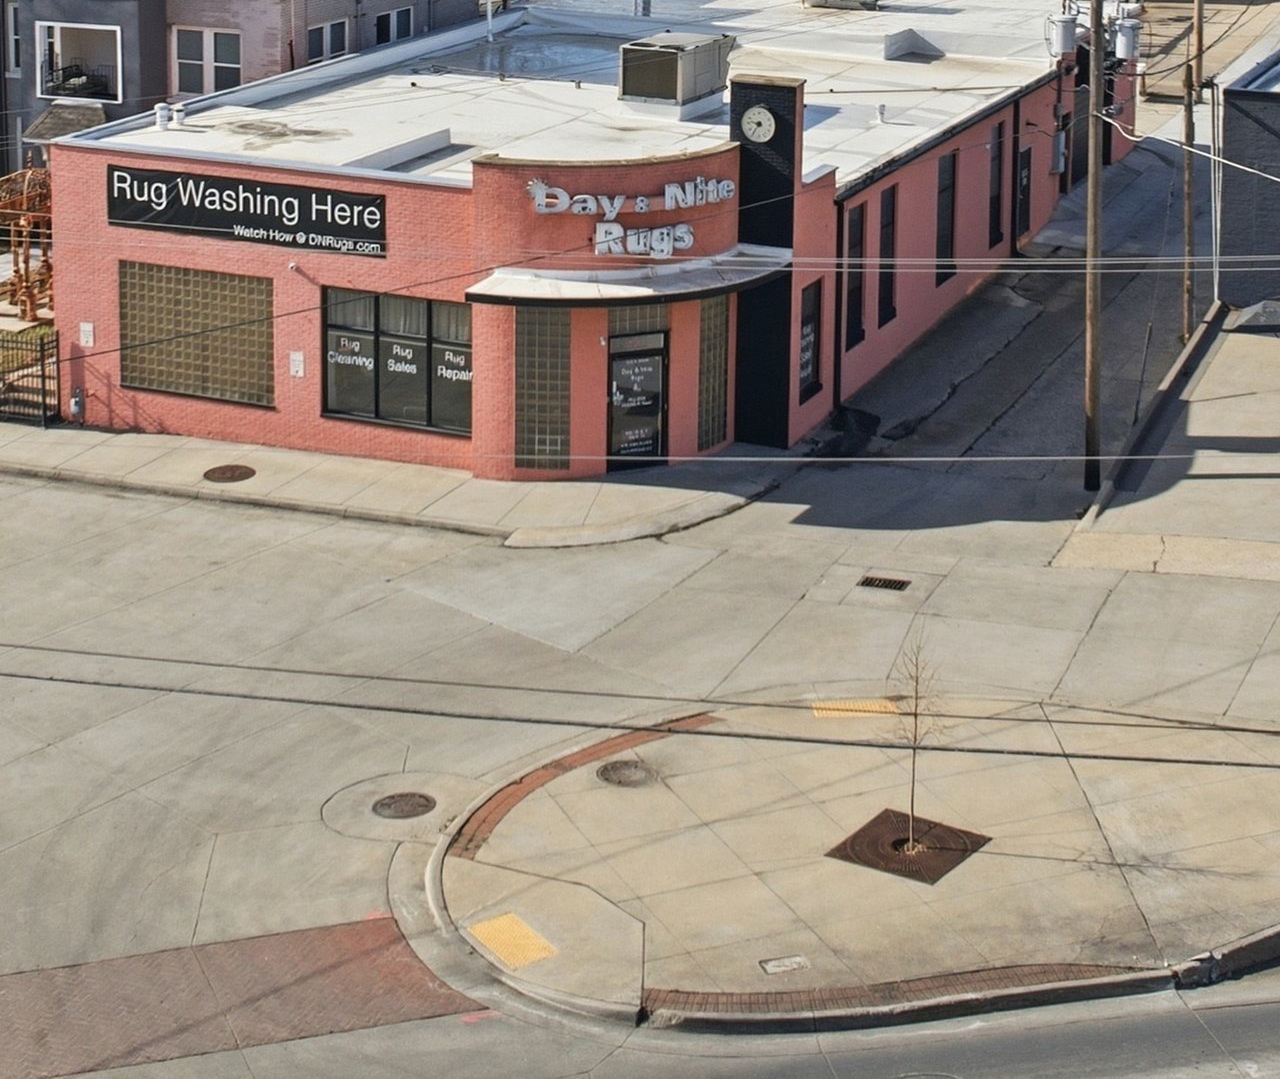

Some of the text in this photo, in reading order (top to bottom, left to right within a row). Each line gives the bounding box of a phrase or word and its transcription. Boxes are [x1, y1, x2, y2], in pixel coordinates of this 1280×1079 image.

[113, 171, 381, 228] Rug Washing Here
[534, 176, 735, 221] Day & Nite
[233, 224, 381, 253] Watch How @ DNRugs.com
[595, 222, 694, 260] Rugs
[340, 337, 361, 352] Rug
[393, 344, 413, 360] Rug
[327, 351, 375, 370] Cleaning
[387, 359, 417, 374] Sales
[445, 351, 465, 366] Rug
[437, 365, 473, 382] Repair
